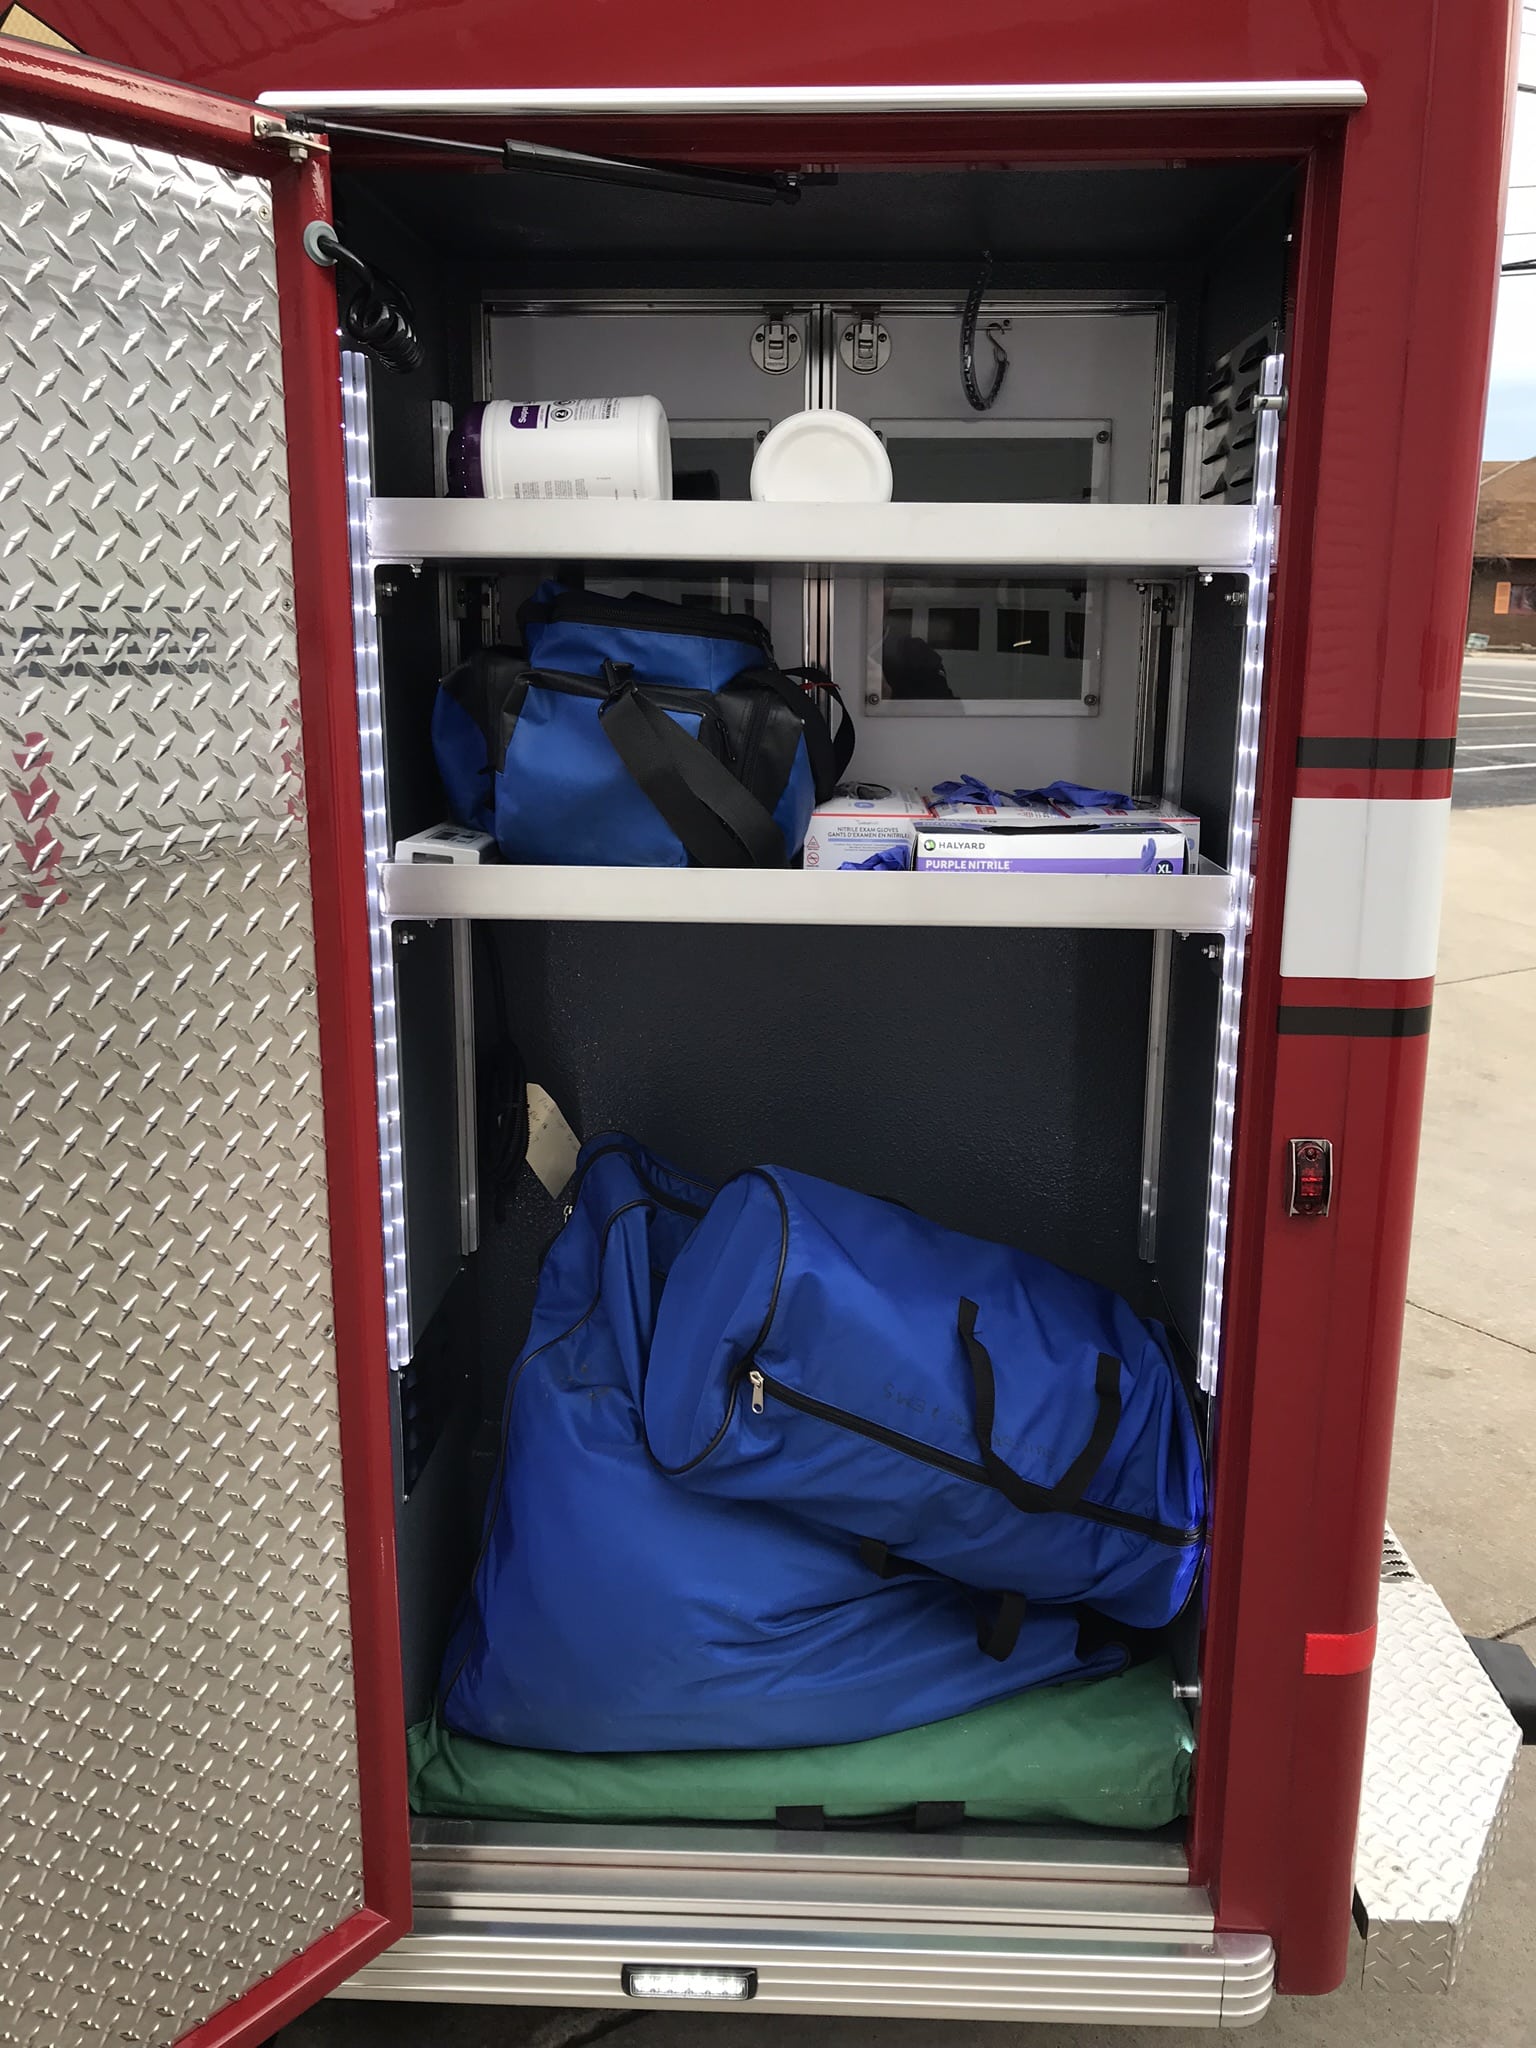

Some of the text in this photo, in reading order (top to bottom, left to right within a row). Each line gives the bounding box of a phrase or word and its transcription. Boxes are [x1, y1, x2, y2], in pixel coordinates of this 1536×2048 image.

[938, 841, 986, 850] HALYARD
[925, 859, 1010, 870] PURPLE NITRILE
[1157, 863, 1173, 874] XL
